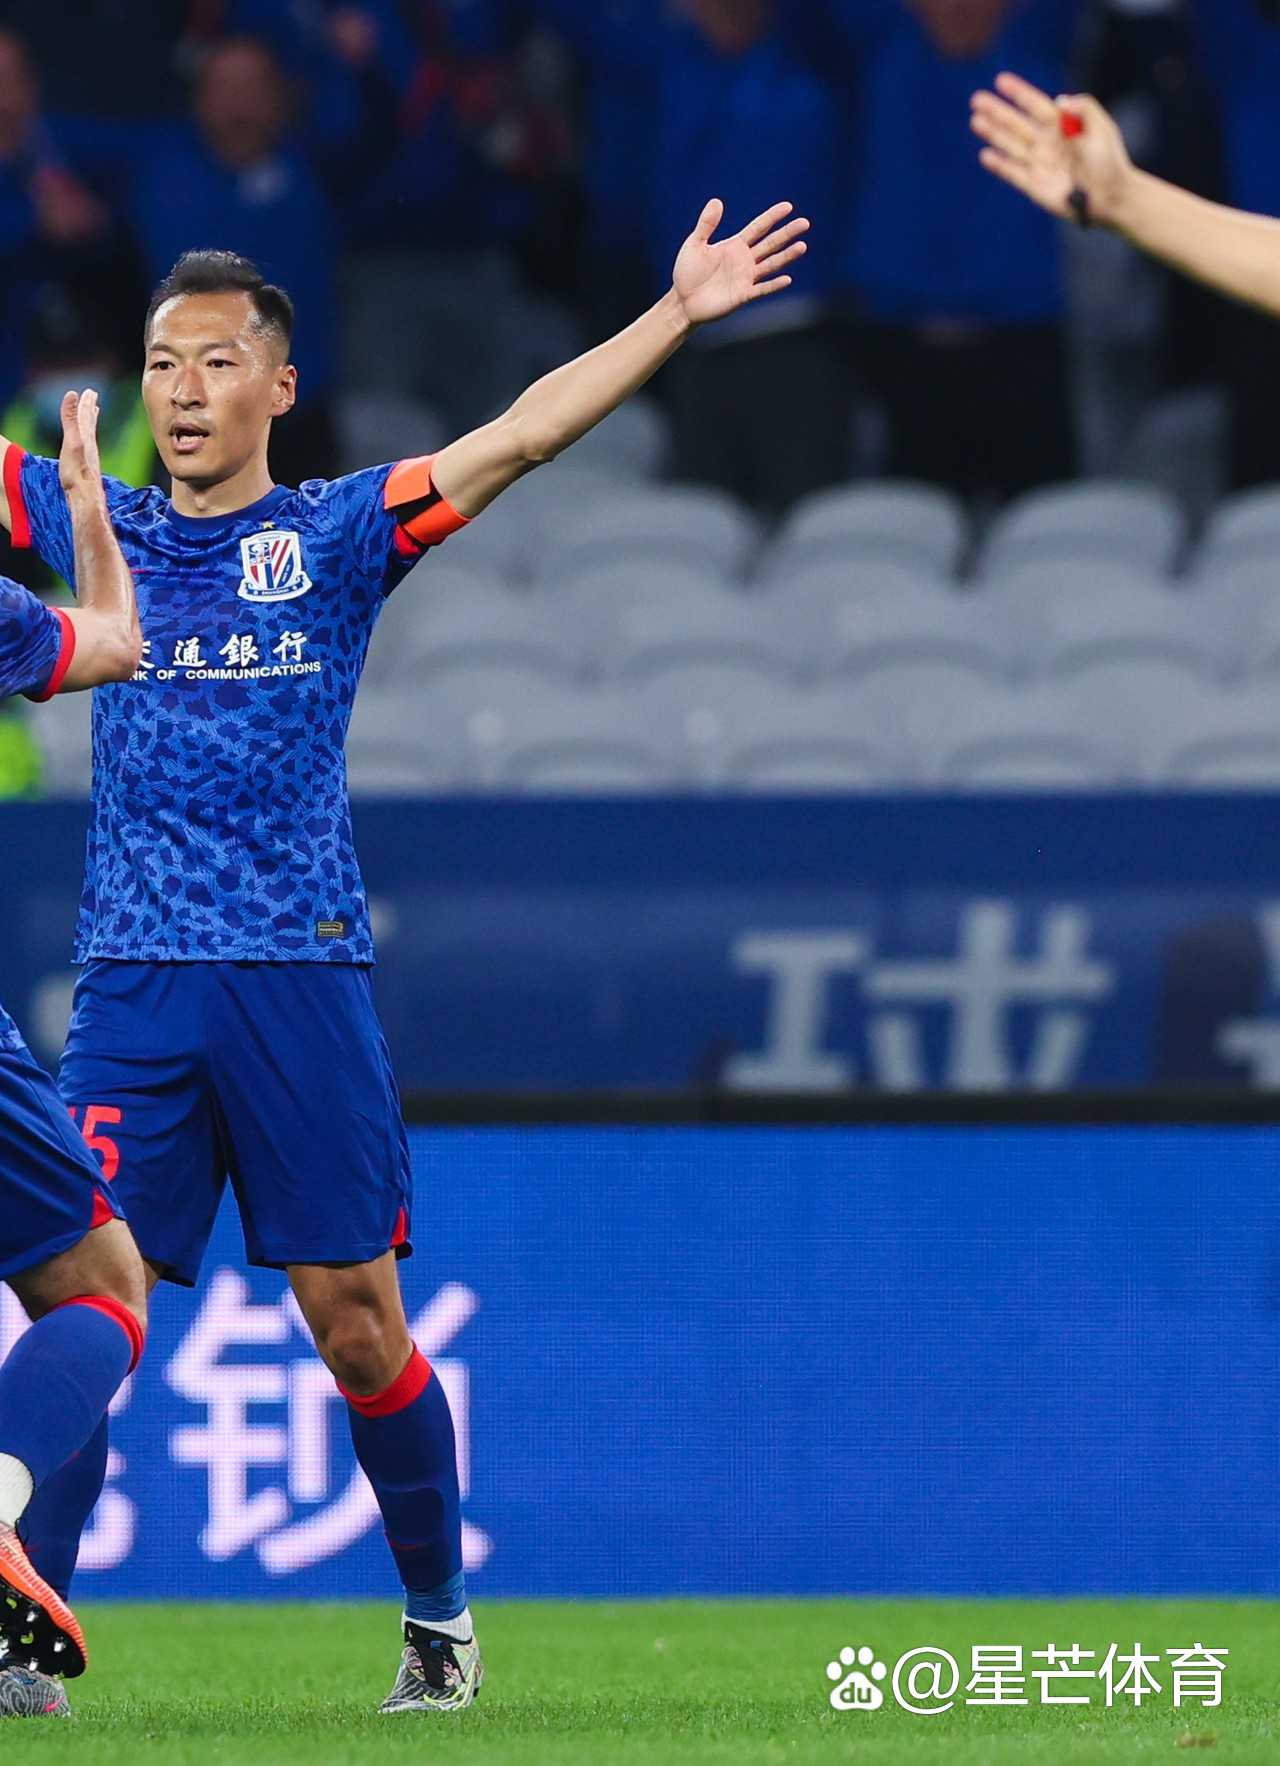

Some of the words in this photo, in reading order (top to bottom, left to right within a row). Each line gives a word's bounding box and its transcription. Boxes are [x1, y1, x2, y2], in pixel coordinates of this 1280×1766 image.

[129, 670, 148, 681] NK
[156, 669, 177, 681] OF
[185, 661, 321, 680] COMMUNICATIONS
[68, 1105, 122, 1183] 5
